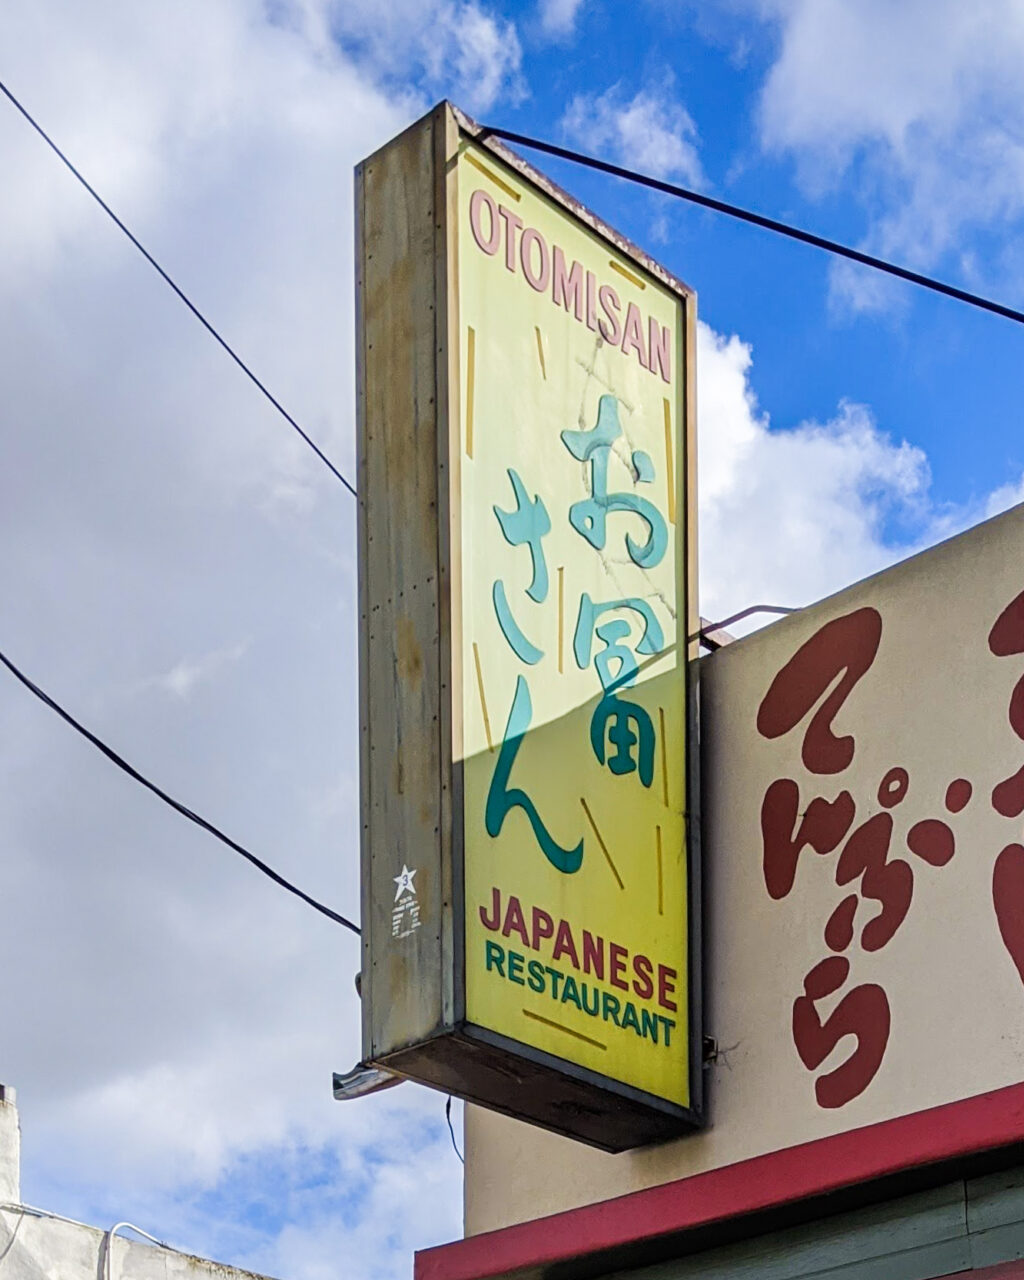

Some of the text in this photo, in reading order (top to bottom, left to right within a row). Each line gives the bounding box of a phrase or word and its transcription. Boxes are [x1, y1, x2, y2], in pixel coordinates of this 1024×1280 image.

[469, 188, 672, 384] OTOMISAN
[756, 606, 956, 1109] てんぷら
[479, 886, 678, 1013] JAPANESE
[484, 939, 676, 1048] RESTAURANT
